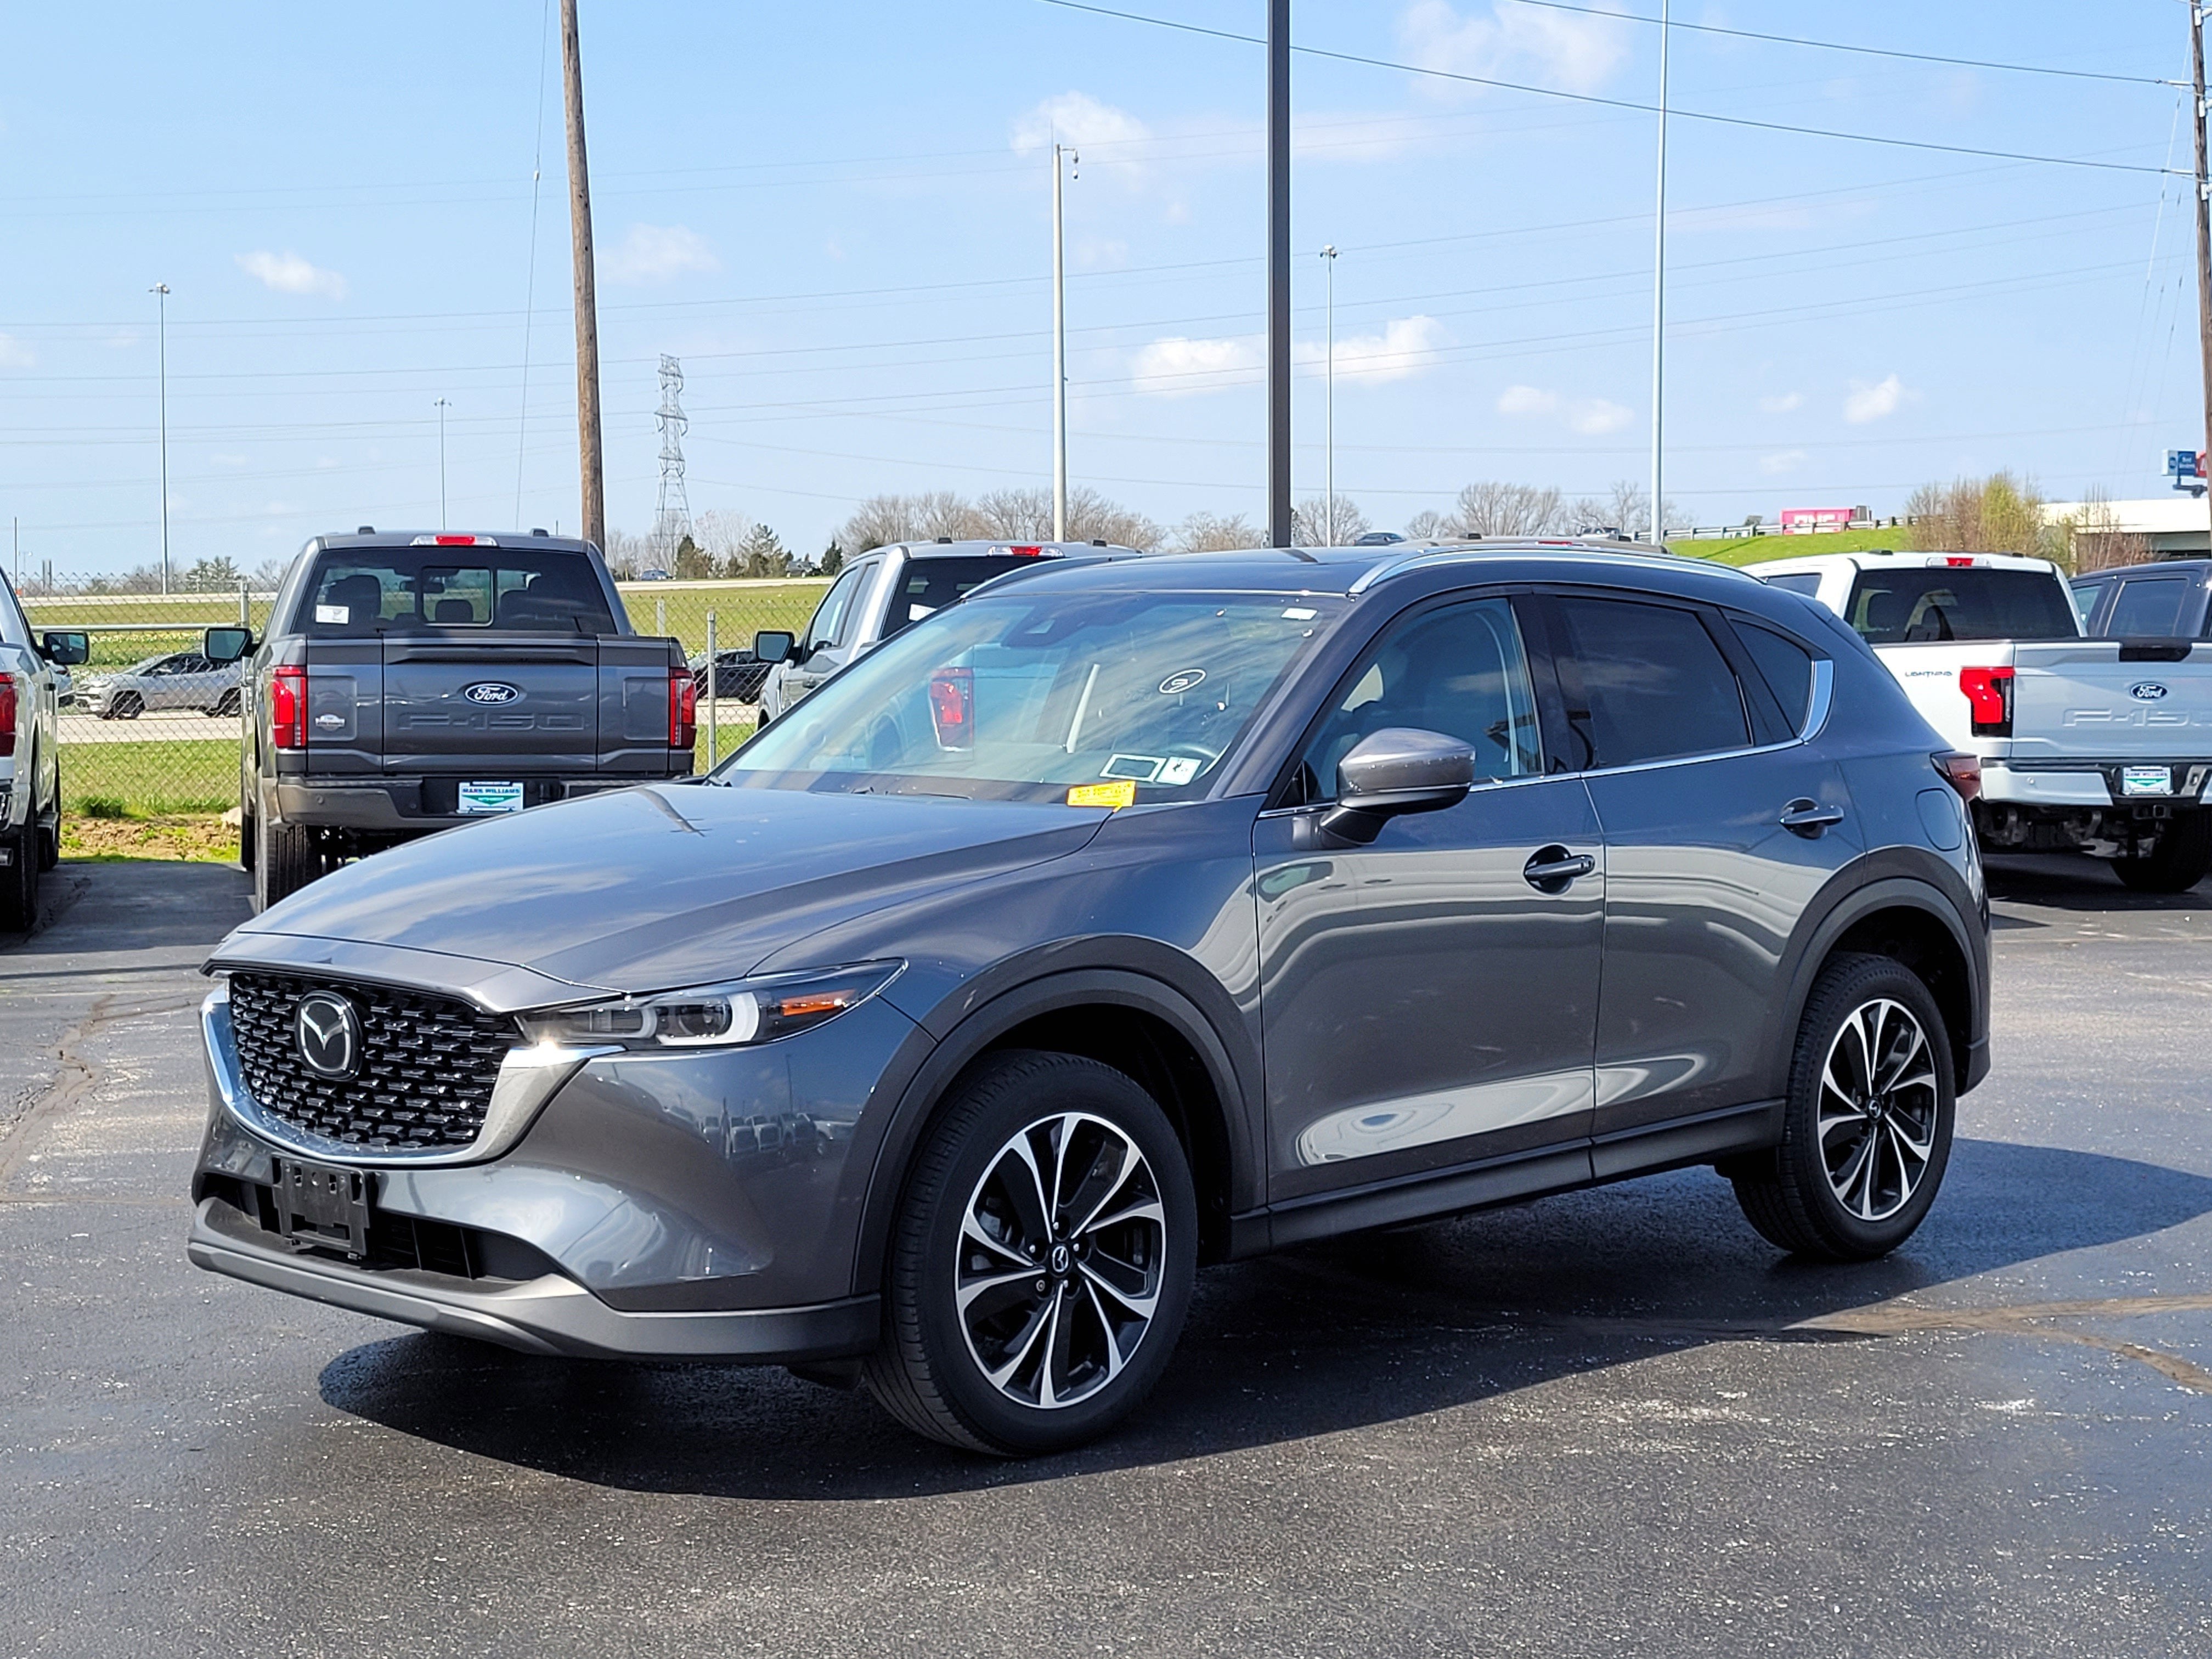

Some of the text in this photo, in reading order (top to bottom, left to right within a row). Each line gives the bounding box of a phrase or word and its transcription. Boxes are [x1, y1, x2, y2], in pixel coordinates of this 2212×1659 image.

[474, 686, 508, 701] Ford
[2137, 685, 2163, 698] Ford
[398, 713, 585, 730] F-150
